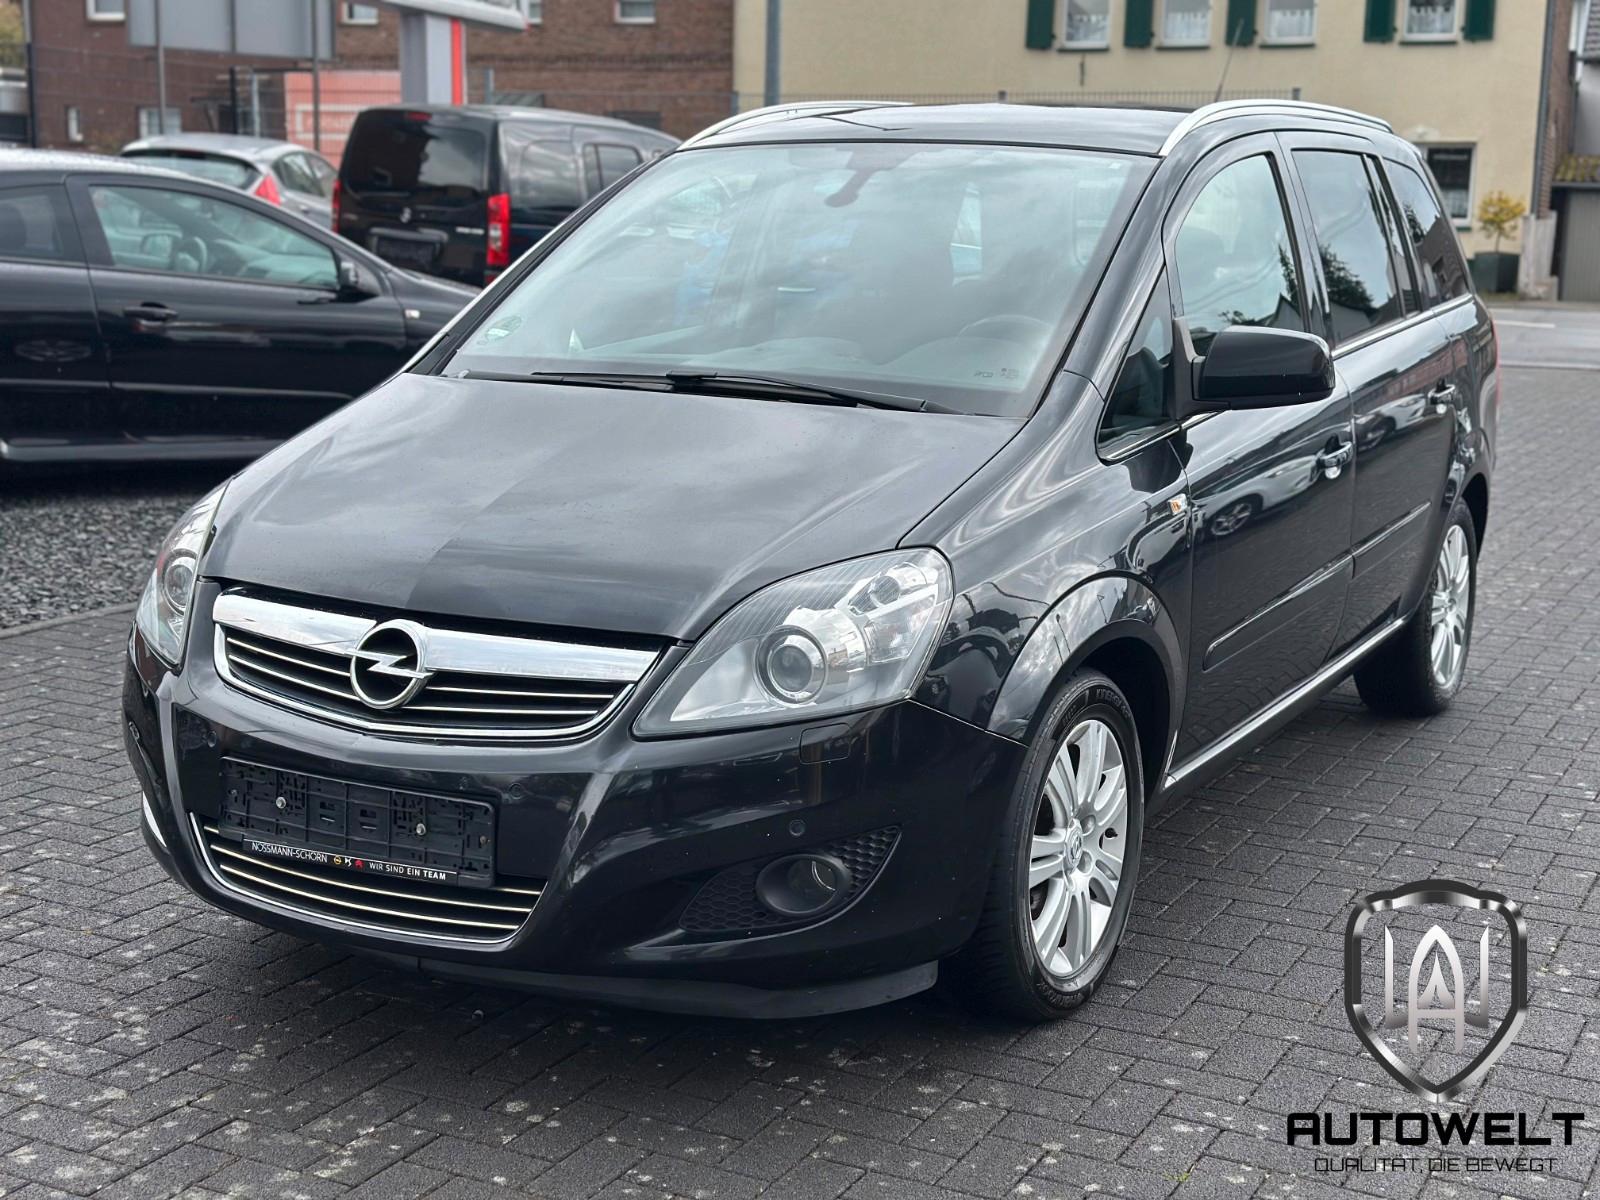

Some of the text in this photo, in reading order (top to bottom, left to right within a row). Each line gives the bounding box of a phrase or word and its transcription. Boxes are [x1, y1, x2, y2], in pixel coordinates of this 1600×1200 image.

[251, 841, 446, 880] NOSSMANN-SCHORN WIR SIND EIN TEAM
